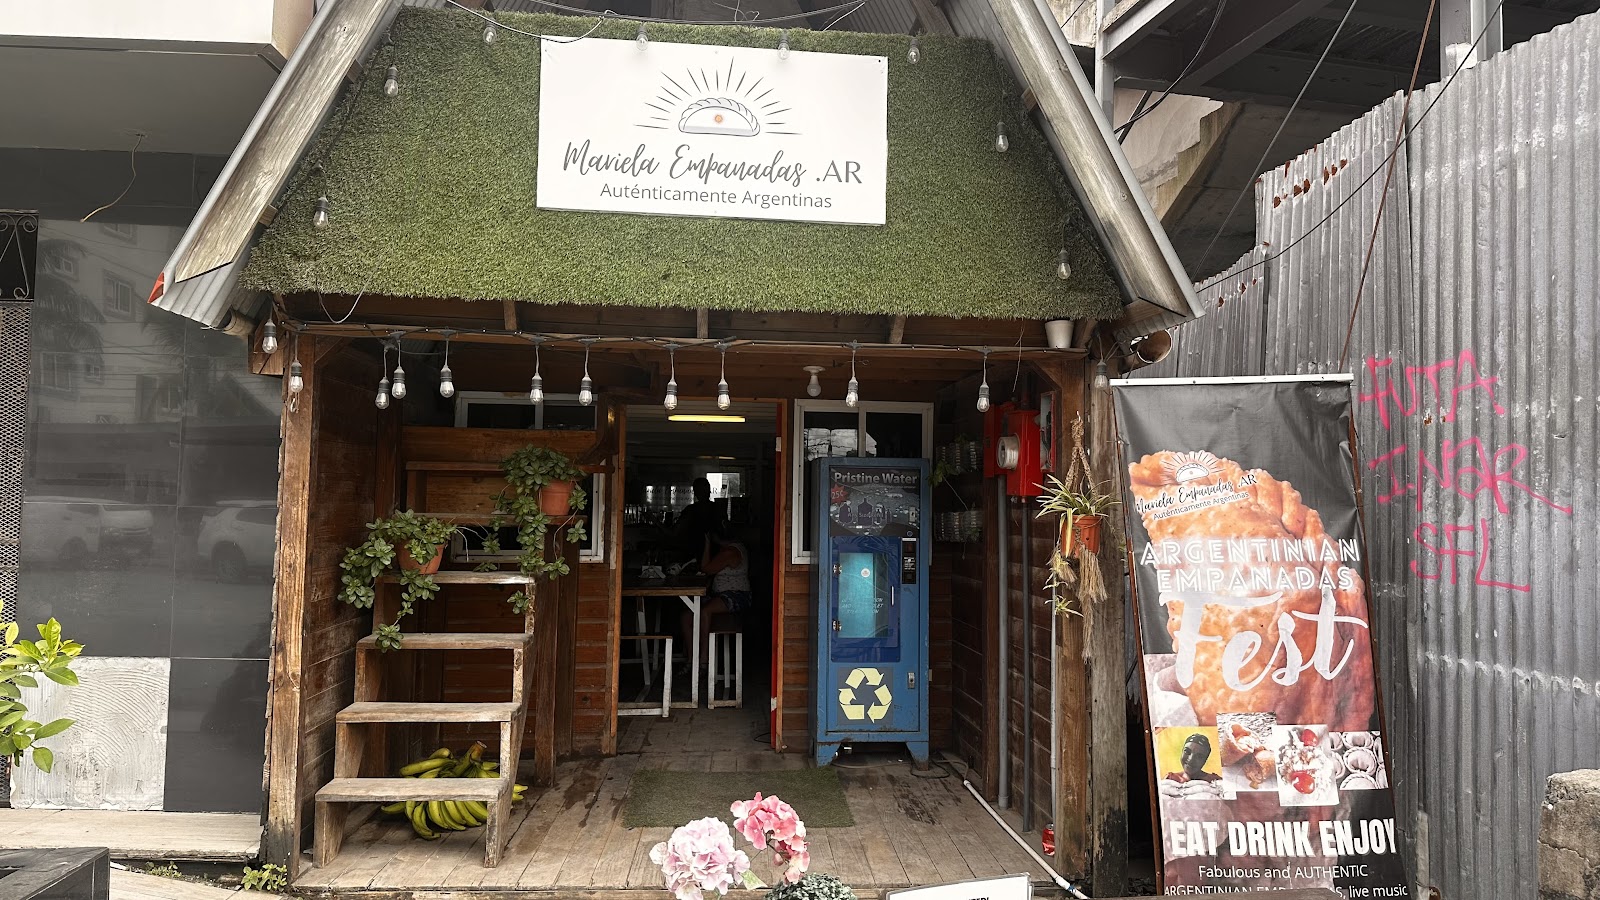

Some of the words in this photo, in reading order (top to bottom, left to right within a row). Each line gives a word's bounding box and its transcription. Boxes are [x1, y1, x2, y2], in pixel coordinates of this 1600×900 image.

[563, 138, 660, 176] Mariela
[669, 144, 807, 187] Empanadas
[815, 160, 863, 184] .AR
[600, 183, 737, 204] Auténticamente
[741, 190, 832, 209] Argentinas
[834, 472, 880, 483] Pristine
[881, 473, 918, 484] Water
[1178, 478, 1234, 503] Empanadas
[1237, 474, 1257, 488] .AR
[1153, 499, 1212, 520] Auténticamente
[1212, 491, 1250, 505] Argentinas
[1140, 538, 1361, 565] ARGENTINIAN
[1156, 566, 1355, 592] EMPANADAS
[1158, 587, 1368, 692] Fest
[1169, 820, 1219, 856] EAT
[1227, 820, 1315, 857] DRINK
[1319, 818, 1397, 855] ENJOY
[1198, 865, 1260, 879] Fabulous
[1265, 865, 1291, 879] and
[1295, 865, 1368, 879] AUTHENTIC
[1349, 885, 1369, 898] live
[1373, 883, 1408, 897] music
